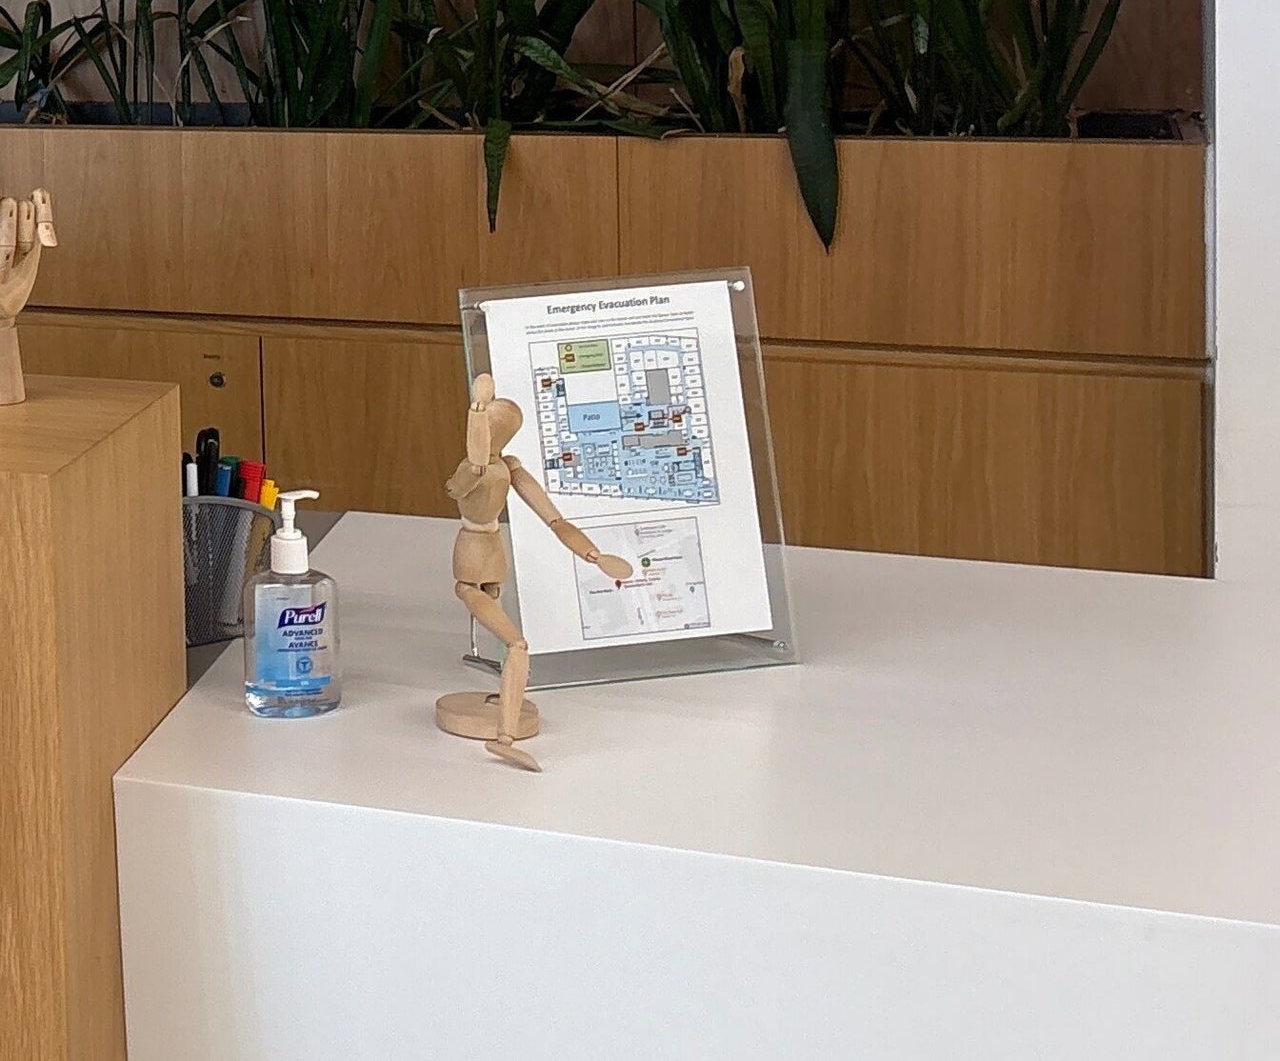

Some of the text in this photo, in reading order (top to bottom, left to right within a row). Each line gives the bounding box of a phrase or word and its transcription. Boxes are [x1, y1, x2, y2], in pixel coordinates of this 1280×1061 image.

[547, 295, 670, 315] Emergency Evacuation Plan
